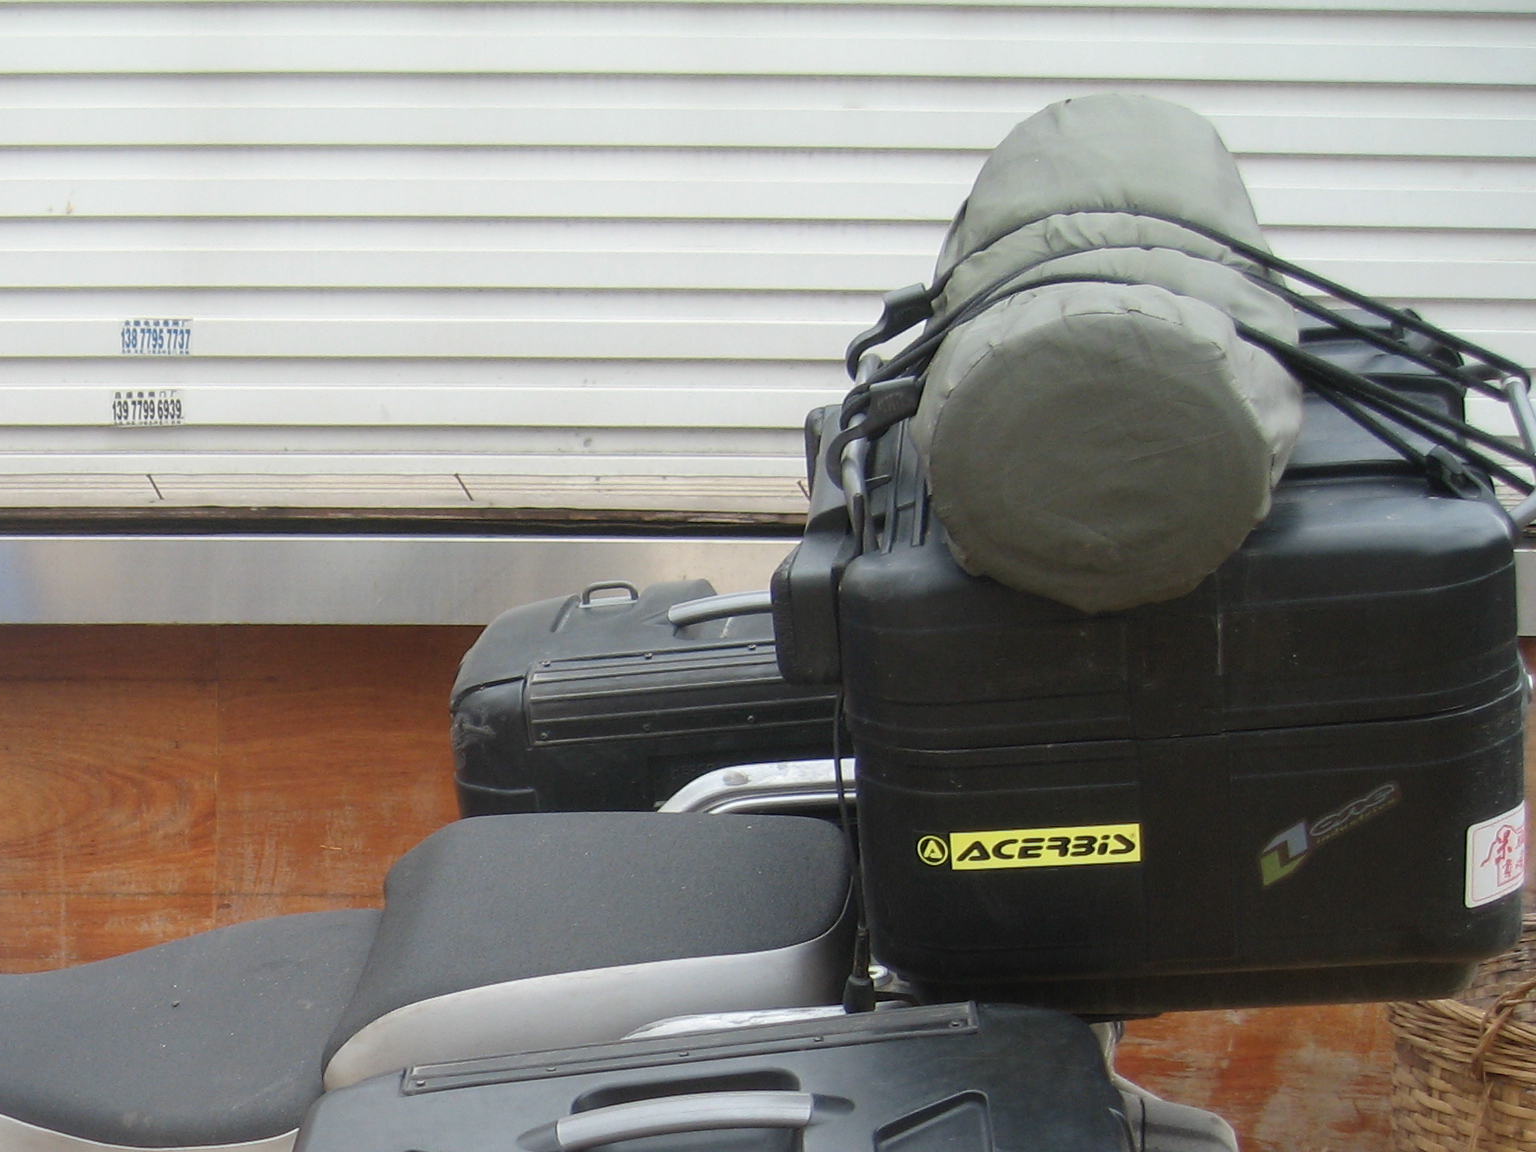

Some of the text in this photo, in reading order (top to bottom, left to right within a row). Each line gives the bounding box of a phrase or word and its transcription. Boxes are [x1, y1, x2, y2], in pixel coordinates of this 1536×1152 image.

[121, 328, 191, 350] 138 7795 7737
[112, 399, 182, 420] 139 7799 6939
